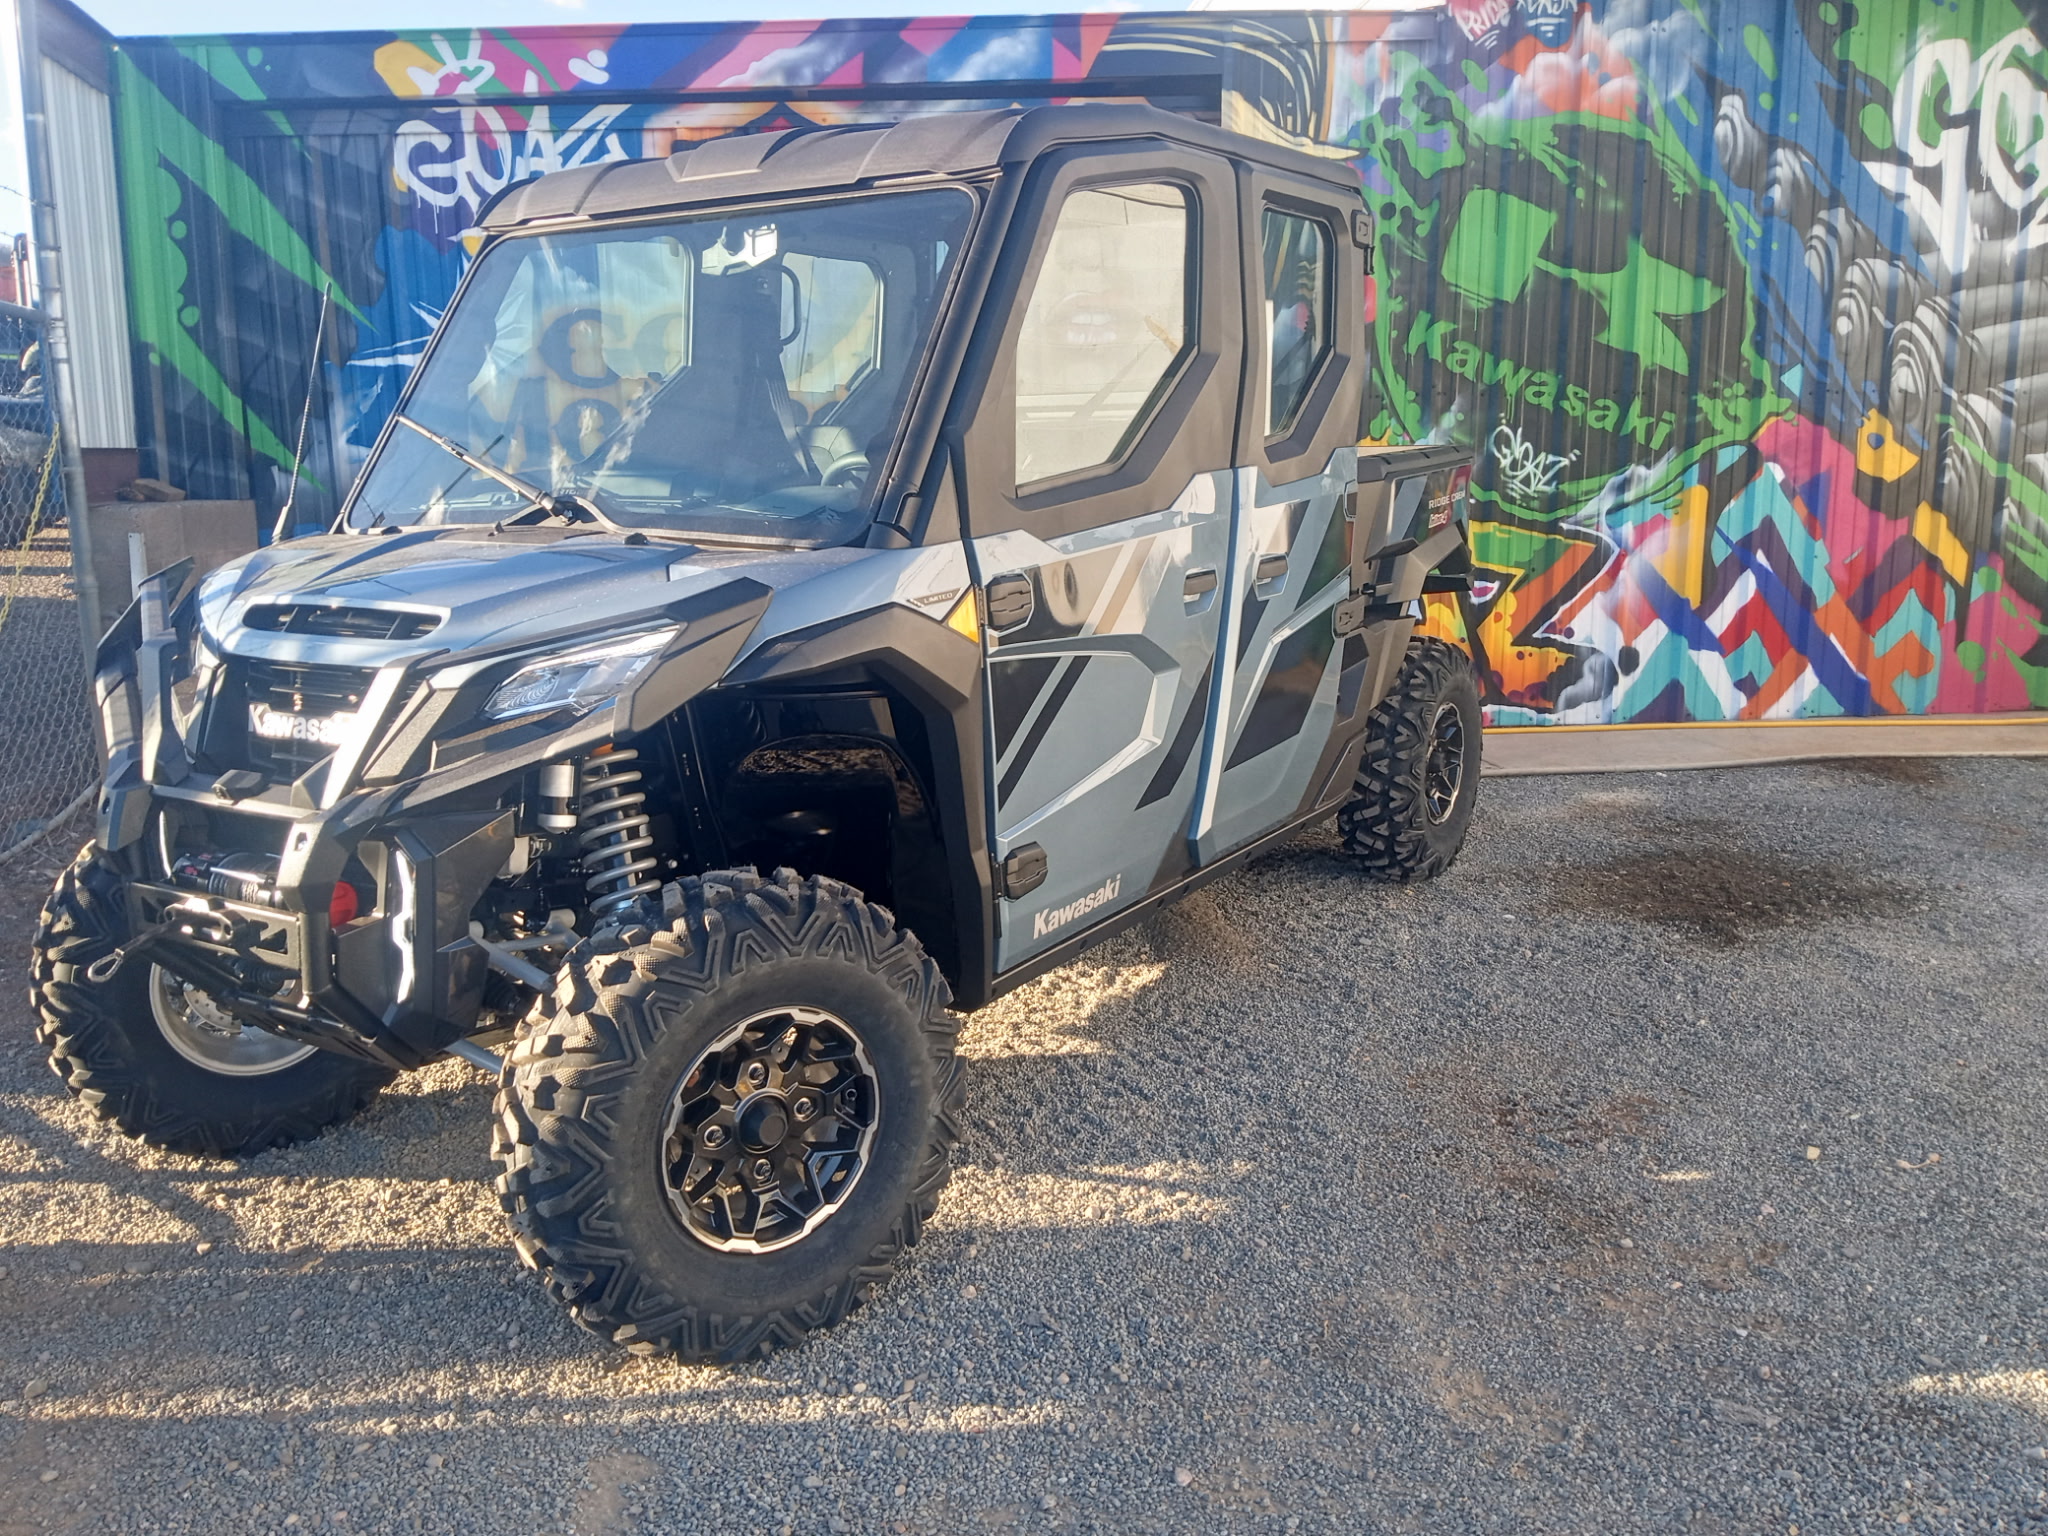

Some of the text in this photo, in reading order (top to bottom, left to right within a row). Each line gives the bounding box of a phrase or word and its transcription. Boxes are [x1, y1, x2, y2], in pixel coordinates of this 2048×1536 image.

[1403, 309, 1677, 451] Kawasaki
[1428, 495, 1450, 510] RIDGE
[923, 592, 953, 604] LIMITED
[247, 702, 346, 745] Kawasa
[1033, 873, 1122, 940] Kawasaki
